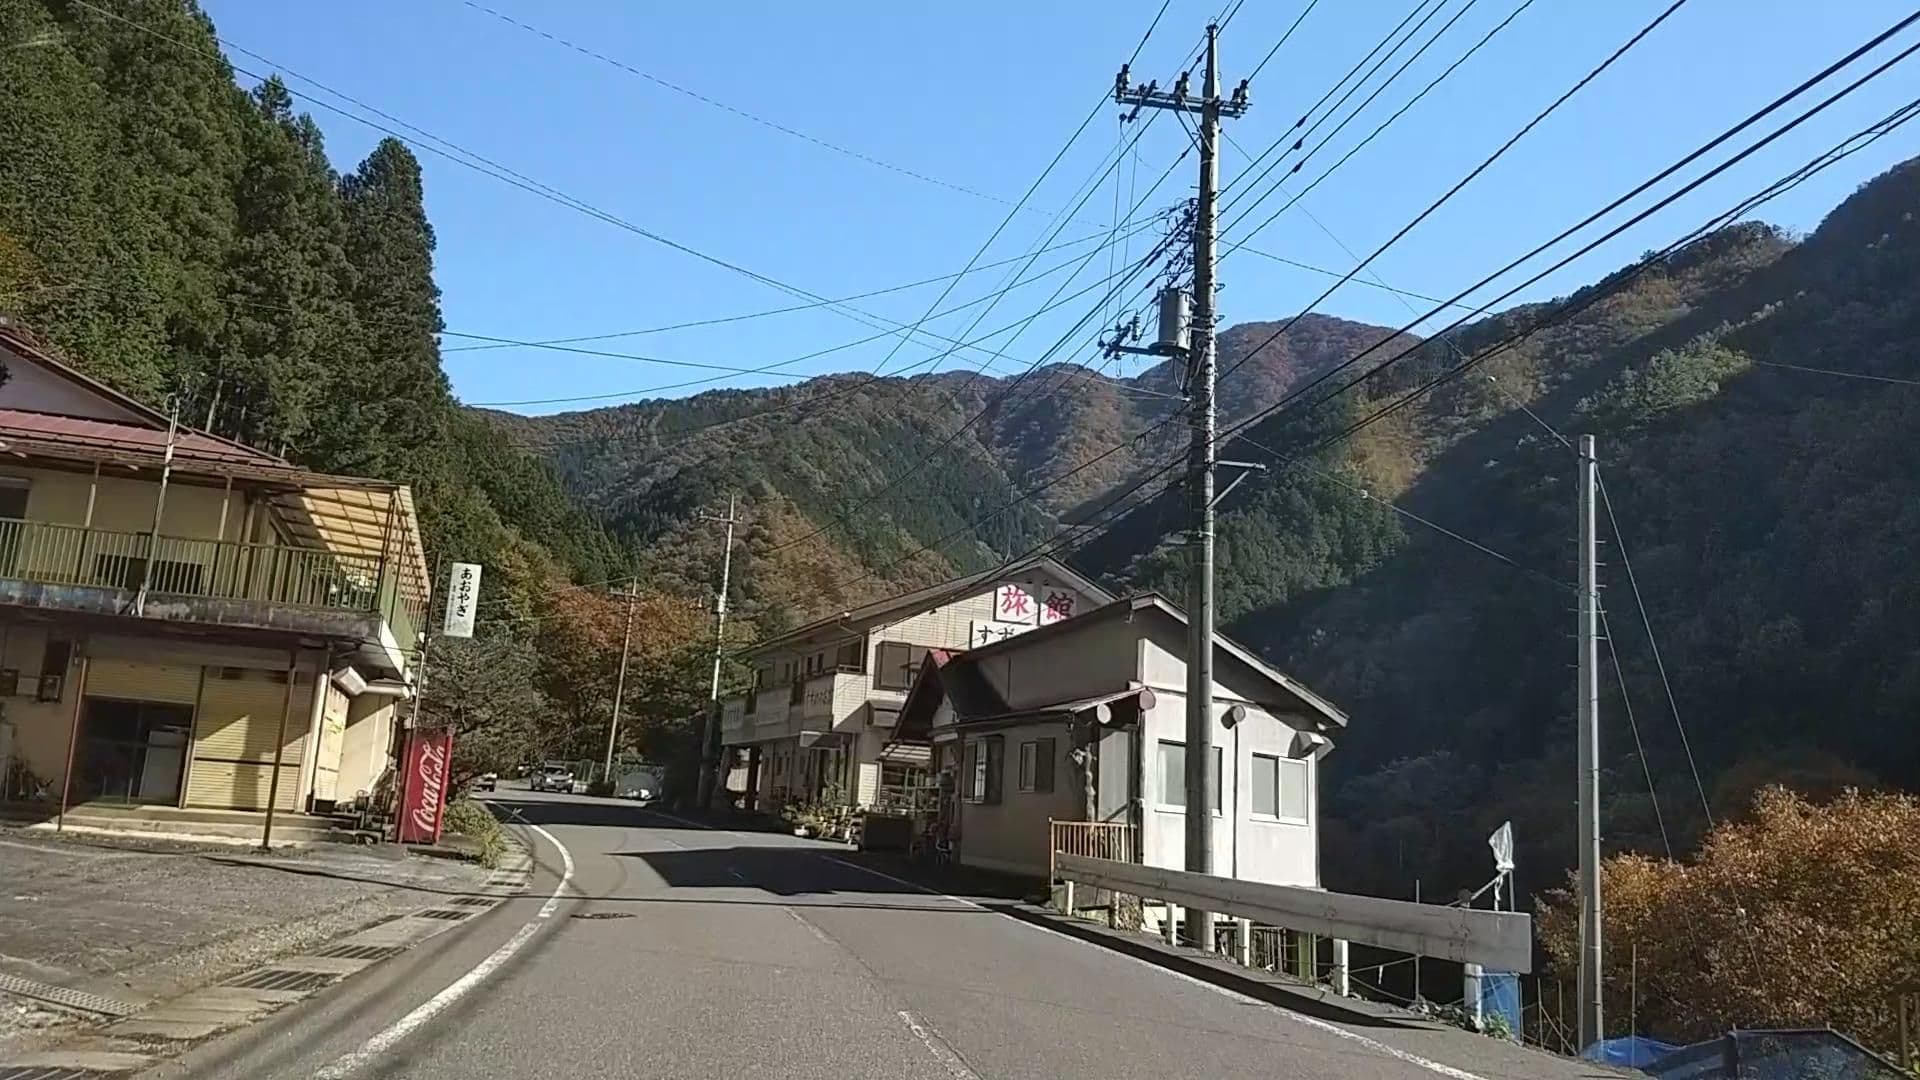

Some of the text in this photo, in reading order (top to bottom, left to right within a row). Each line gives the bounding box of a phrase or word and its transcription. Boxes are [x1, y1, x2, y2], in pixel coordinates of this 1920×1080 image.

[456, 567, 472, 617] あおやぎ
[1001, 585, 1074, 619] 旅館
[976, 625, 1023, 645] すず
